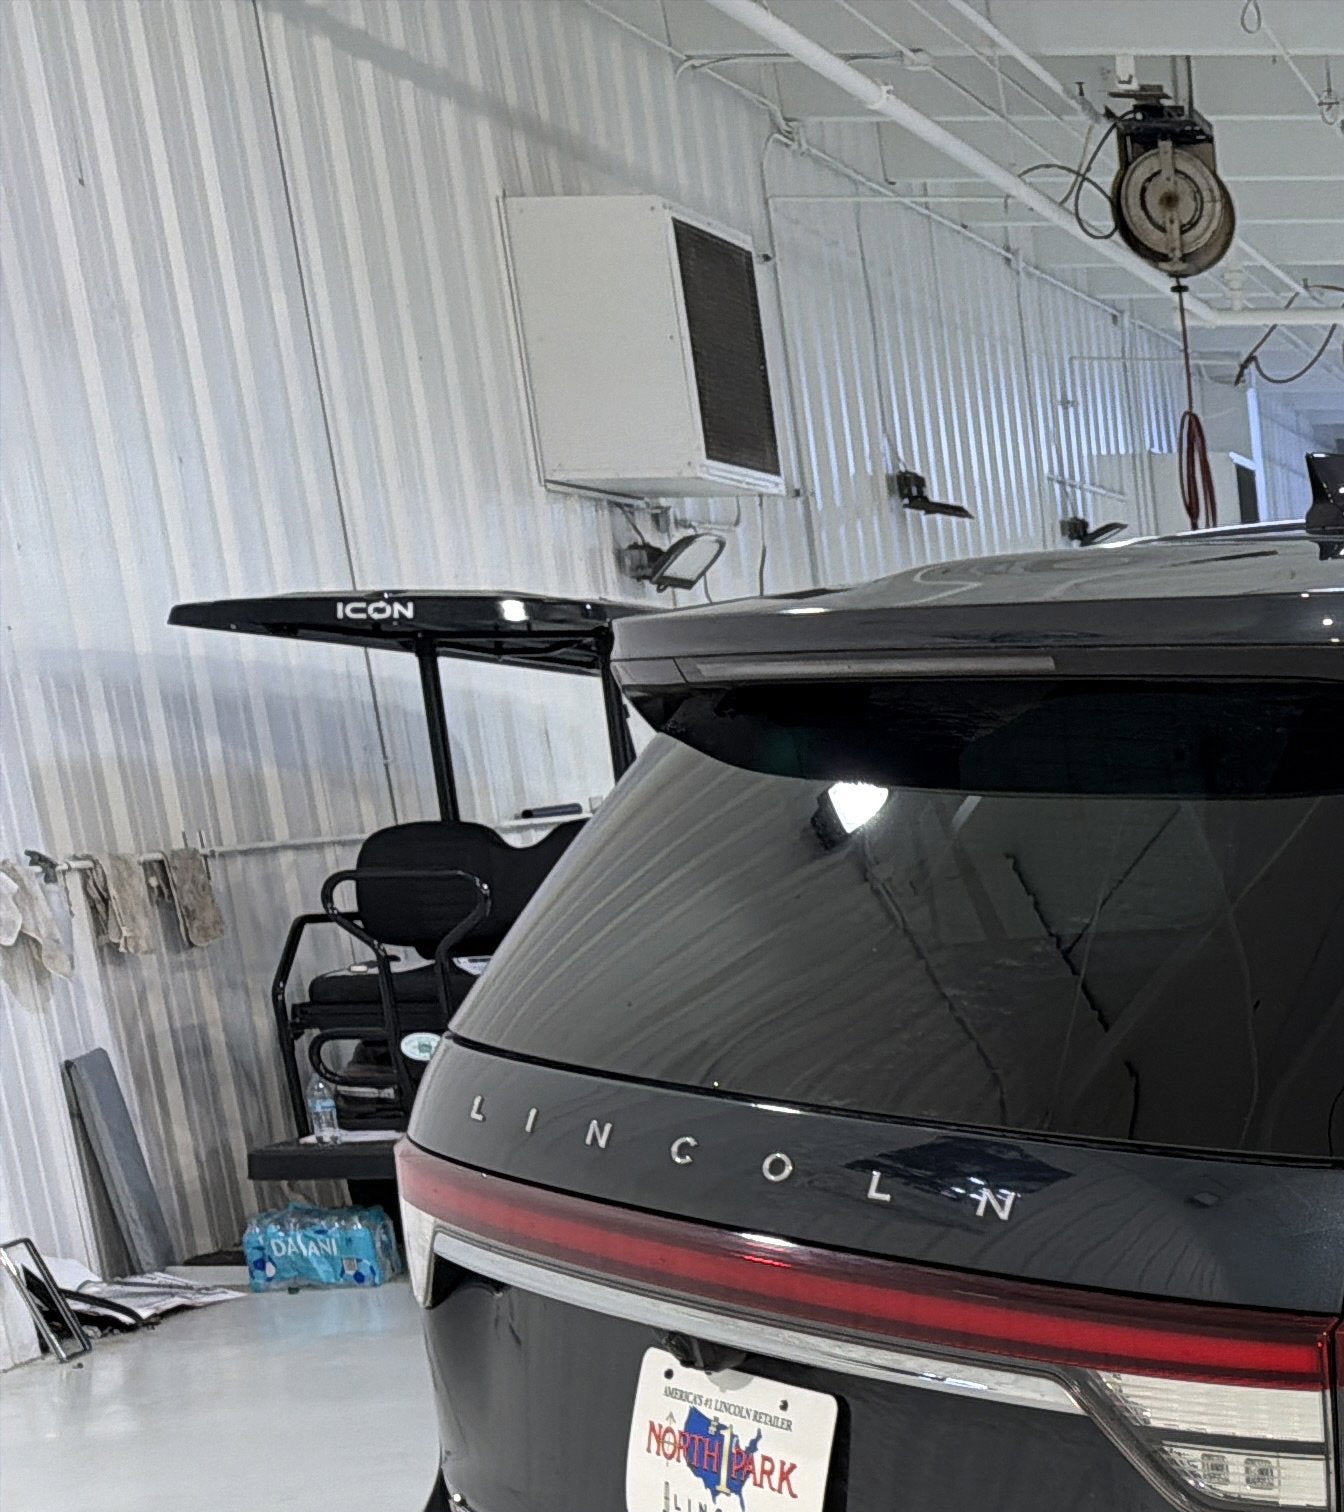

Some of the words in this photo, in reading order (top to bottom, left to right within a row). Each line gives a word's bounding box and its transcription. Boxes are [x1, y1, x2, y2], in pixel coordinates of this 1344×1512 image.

[336, 601, 414, 620] ICON
[469, 1095, 1018, 1221] LINCOLN
[714, 1399, 752, 1420] LINCOLN
[752, 1409, 793, 1432] RETAILER
[646, 1420, 721, 1474] NORTH
[730, 1447, 799, 1499] PARK
